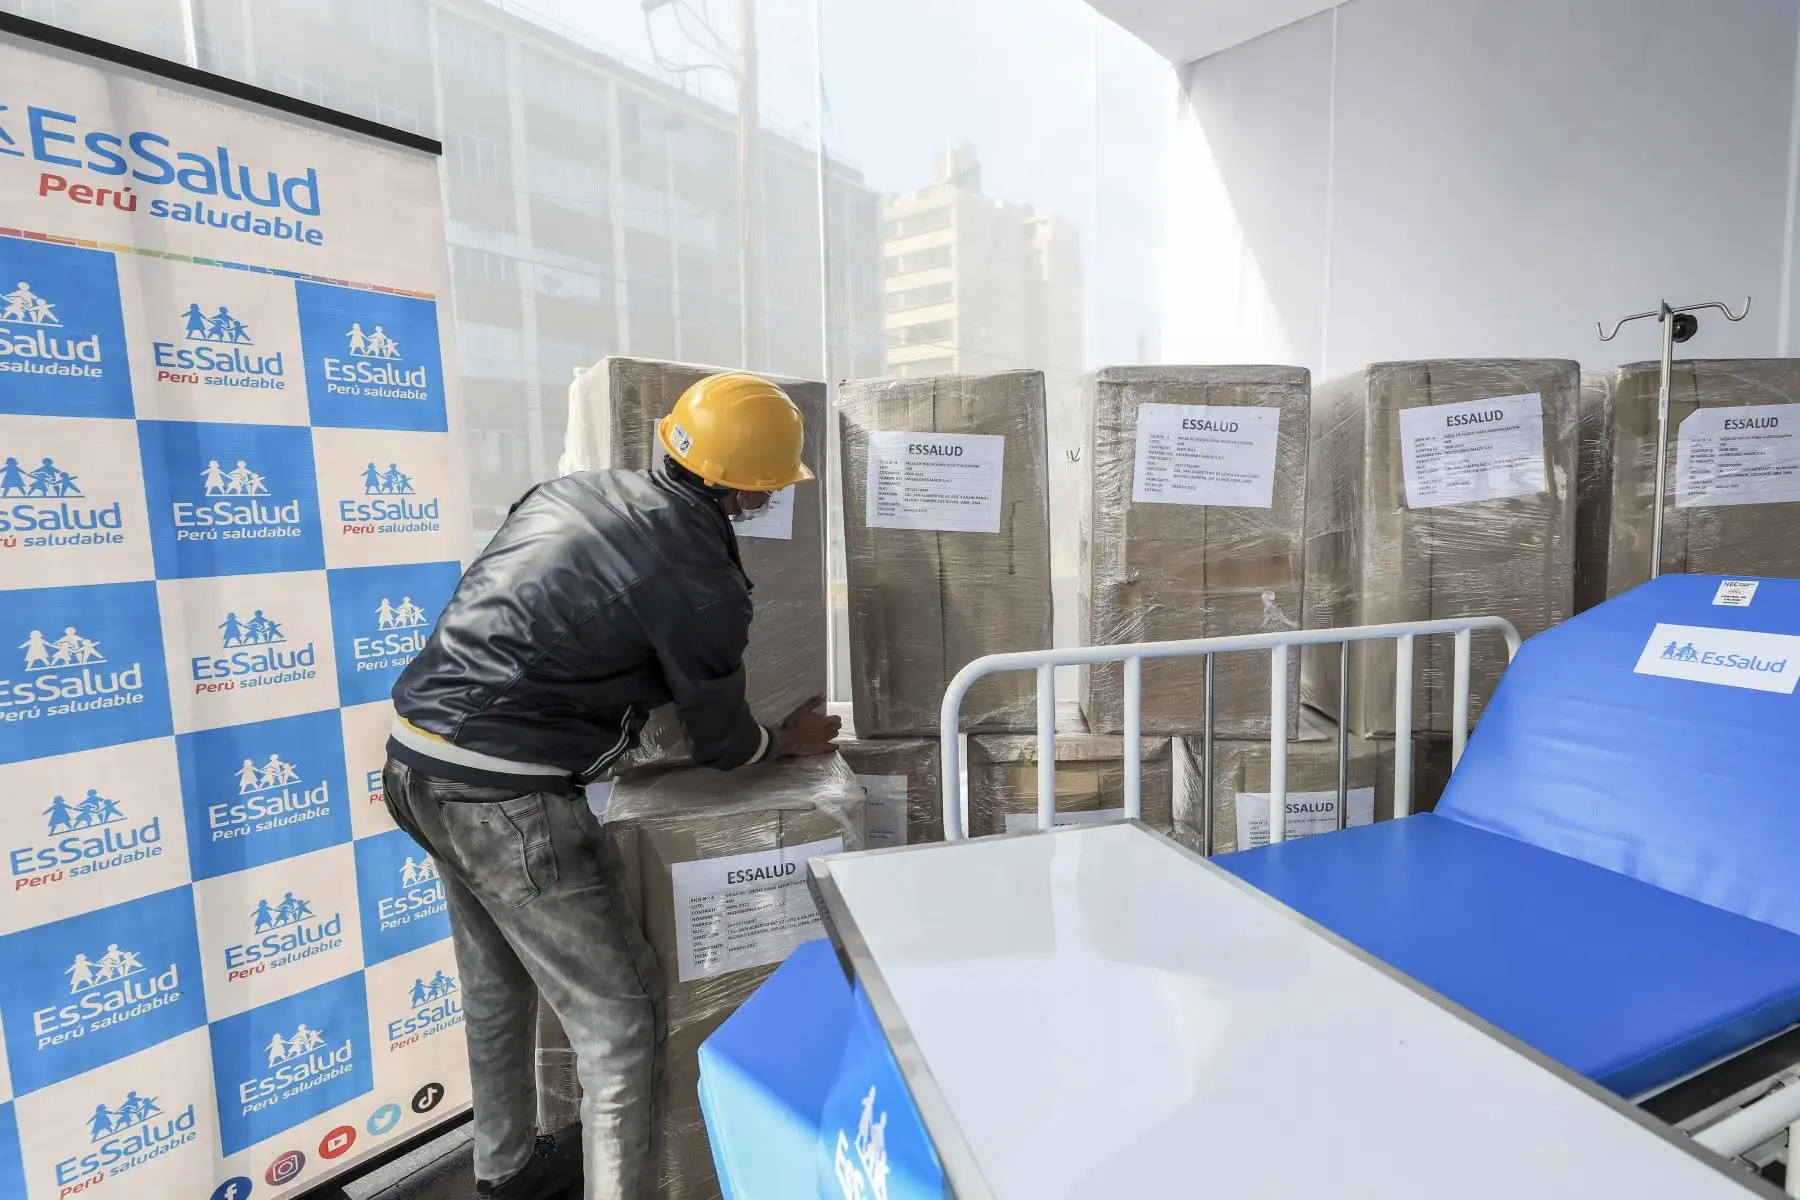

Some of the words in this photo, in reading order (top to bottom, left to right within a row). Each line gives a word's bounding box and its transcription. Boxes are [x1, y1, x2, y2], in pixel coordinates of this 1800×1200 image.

[27, 105, 321, 216] EsSalud
[39, 173, 137, 212] Perú
[150, 199, 324, 246] saludable
[0, 328, 101, 362] Salud
[153, 342, 284, 377] EsSalud
[0, 360, 103, 377] saludable
[157, 370, 199, 385] Perú
[204, 373, 285, 390] saludable
[324, 358, 428, 388] EsSalud
[327, 383, 361, 397] Perú
[363, 387, 428, 400] saludable
[1182, 418, 1239, 433] ESSALUD
[1446, 409, 1504, 427] ESSALUD
[1724, 417, 1779, 430] ESSALUD
[908, 443, 964, 457] ESSALUD
[0, 502, 122, 532] sSalud
[172, 499, 300, 528] EsSalud
[339, 498, 439, 522] EsSalud
[23, 532, 124, 547] saludable
[177, 528, 218, 542] Perú
[222, 526, 301, 540] saludable
[343, 522, 375, 535] Perú
[377, 521, 440, 534] saludable
[353, 630, 427, 660] EsSal
[191, 642, 315, 681] EsSalud
[356, 658, 388, 672] Perú
[1701, 651, 1787, 673] EsSalud
[195, 678, 235, 695] Perú
[239, 668, 316, 689] saludable
[47, 693, 144, 716] saludable
[208, 781, 329, 830] EsSalud
[1286, 802, 1334, 814] SSALUD
[212, 824, 250, 841] Perú
[255, 805, 330, 833] saludable
[10, 817, 162, 876] EsSalud
[15, 869, 63, 891] Perú
[70, 844, 162, 878] saludable
[727, 862, 796, 885] ESSALUD
[378, 880, 445, 920] EsSal
[381, 913, 410, 932] Perú
[413, 901, 447, 920] salud
[225, 912, 342, 971] EsSalud
[229, 962, 266, 983] Perú
[270, 936, 342, 969] saludable
[33, 964, 179, 1036] EsSalud
[38, 1024, 82, 1050] Perú
[90, 992, 180, 1031] saludable
[388, 999, 463, 1041] EsSalu
[390, 1032, 419, 1052] Perú
[423, 1015, 465, 1038] saluda
[240, 1039, 352, 1103] EsSalud
[243, 1093, 278, 1116] Perú
[282, 1062, 353, 1099] saludable
[55, 1104, 195, 1187] EsSalud
[60, 1171, 104, 1200] Perú
[109, 1131, 197, 1178] saludable
